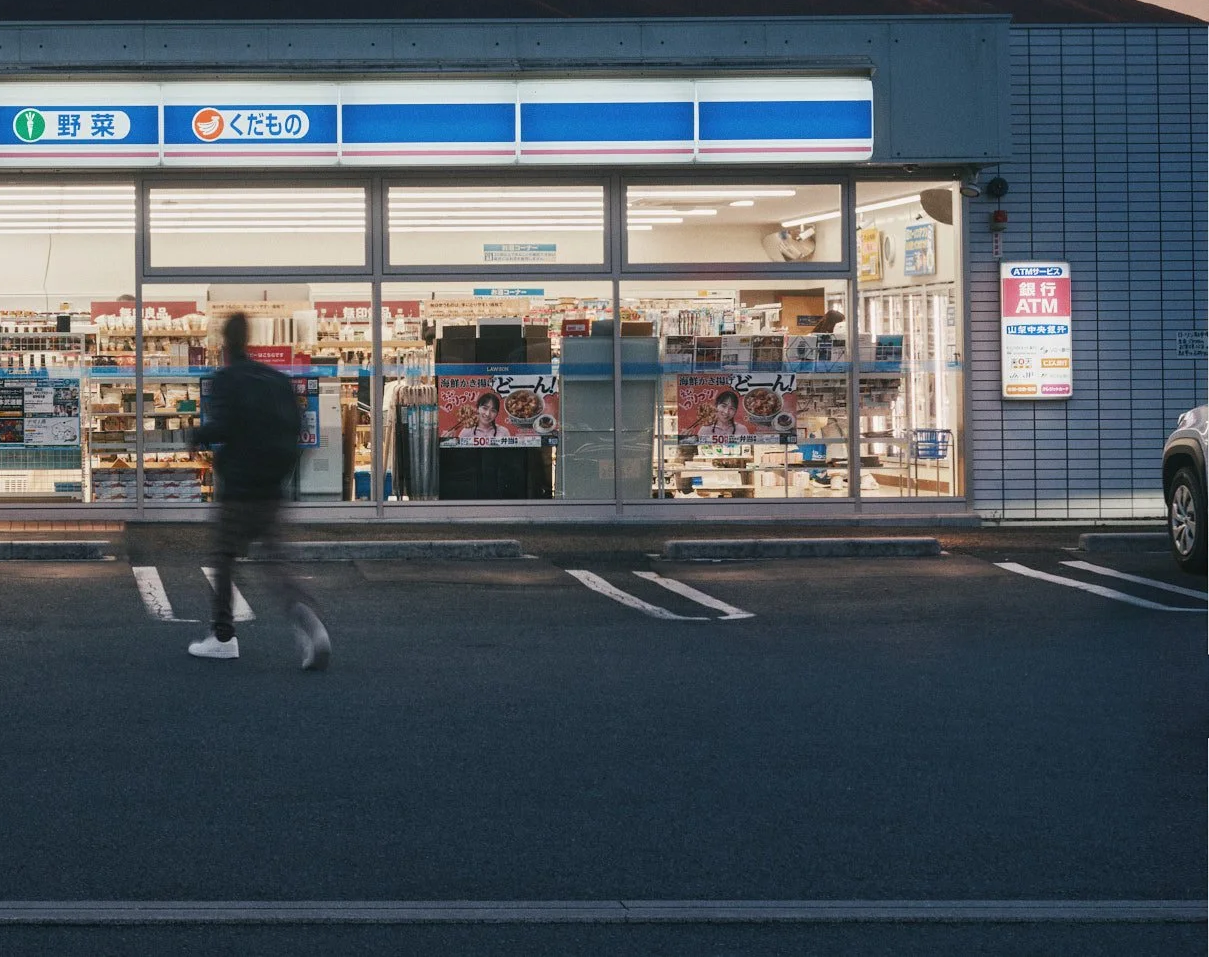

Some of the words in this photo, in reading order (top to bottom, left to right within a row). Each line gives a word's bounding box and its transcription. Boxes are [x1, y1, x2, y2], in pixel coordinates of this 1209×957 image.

[57, 113, 115, 138] 野菜
[229, 112, 302, 137] くだもの
[1013, 267, 1061, 276] ATMサービス
[1019, 282, 1056, 297] 銀行
[1015, 298, 1058, 314] ATM
[1007, 325, 1067, 335] 山梨中央銀行
